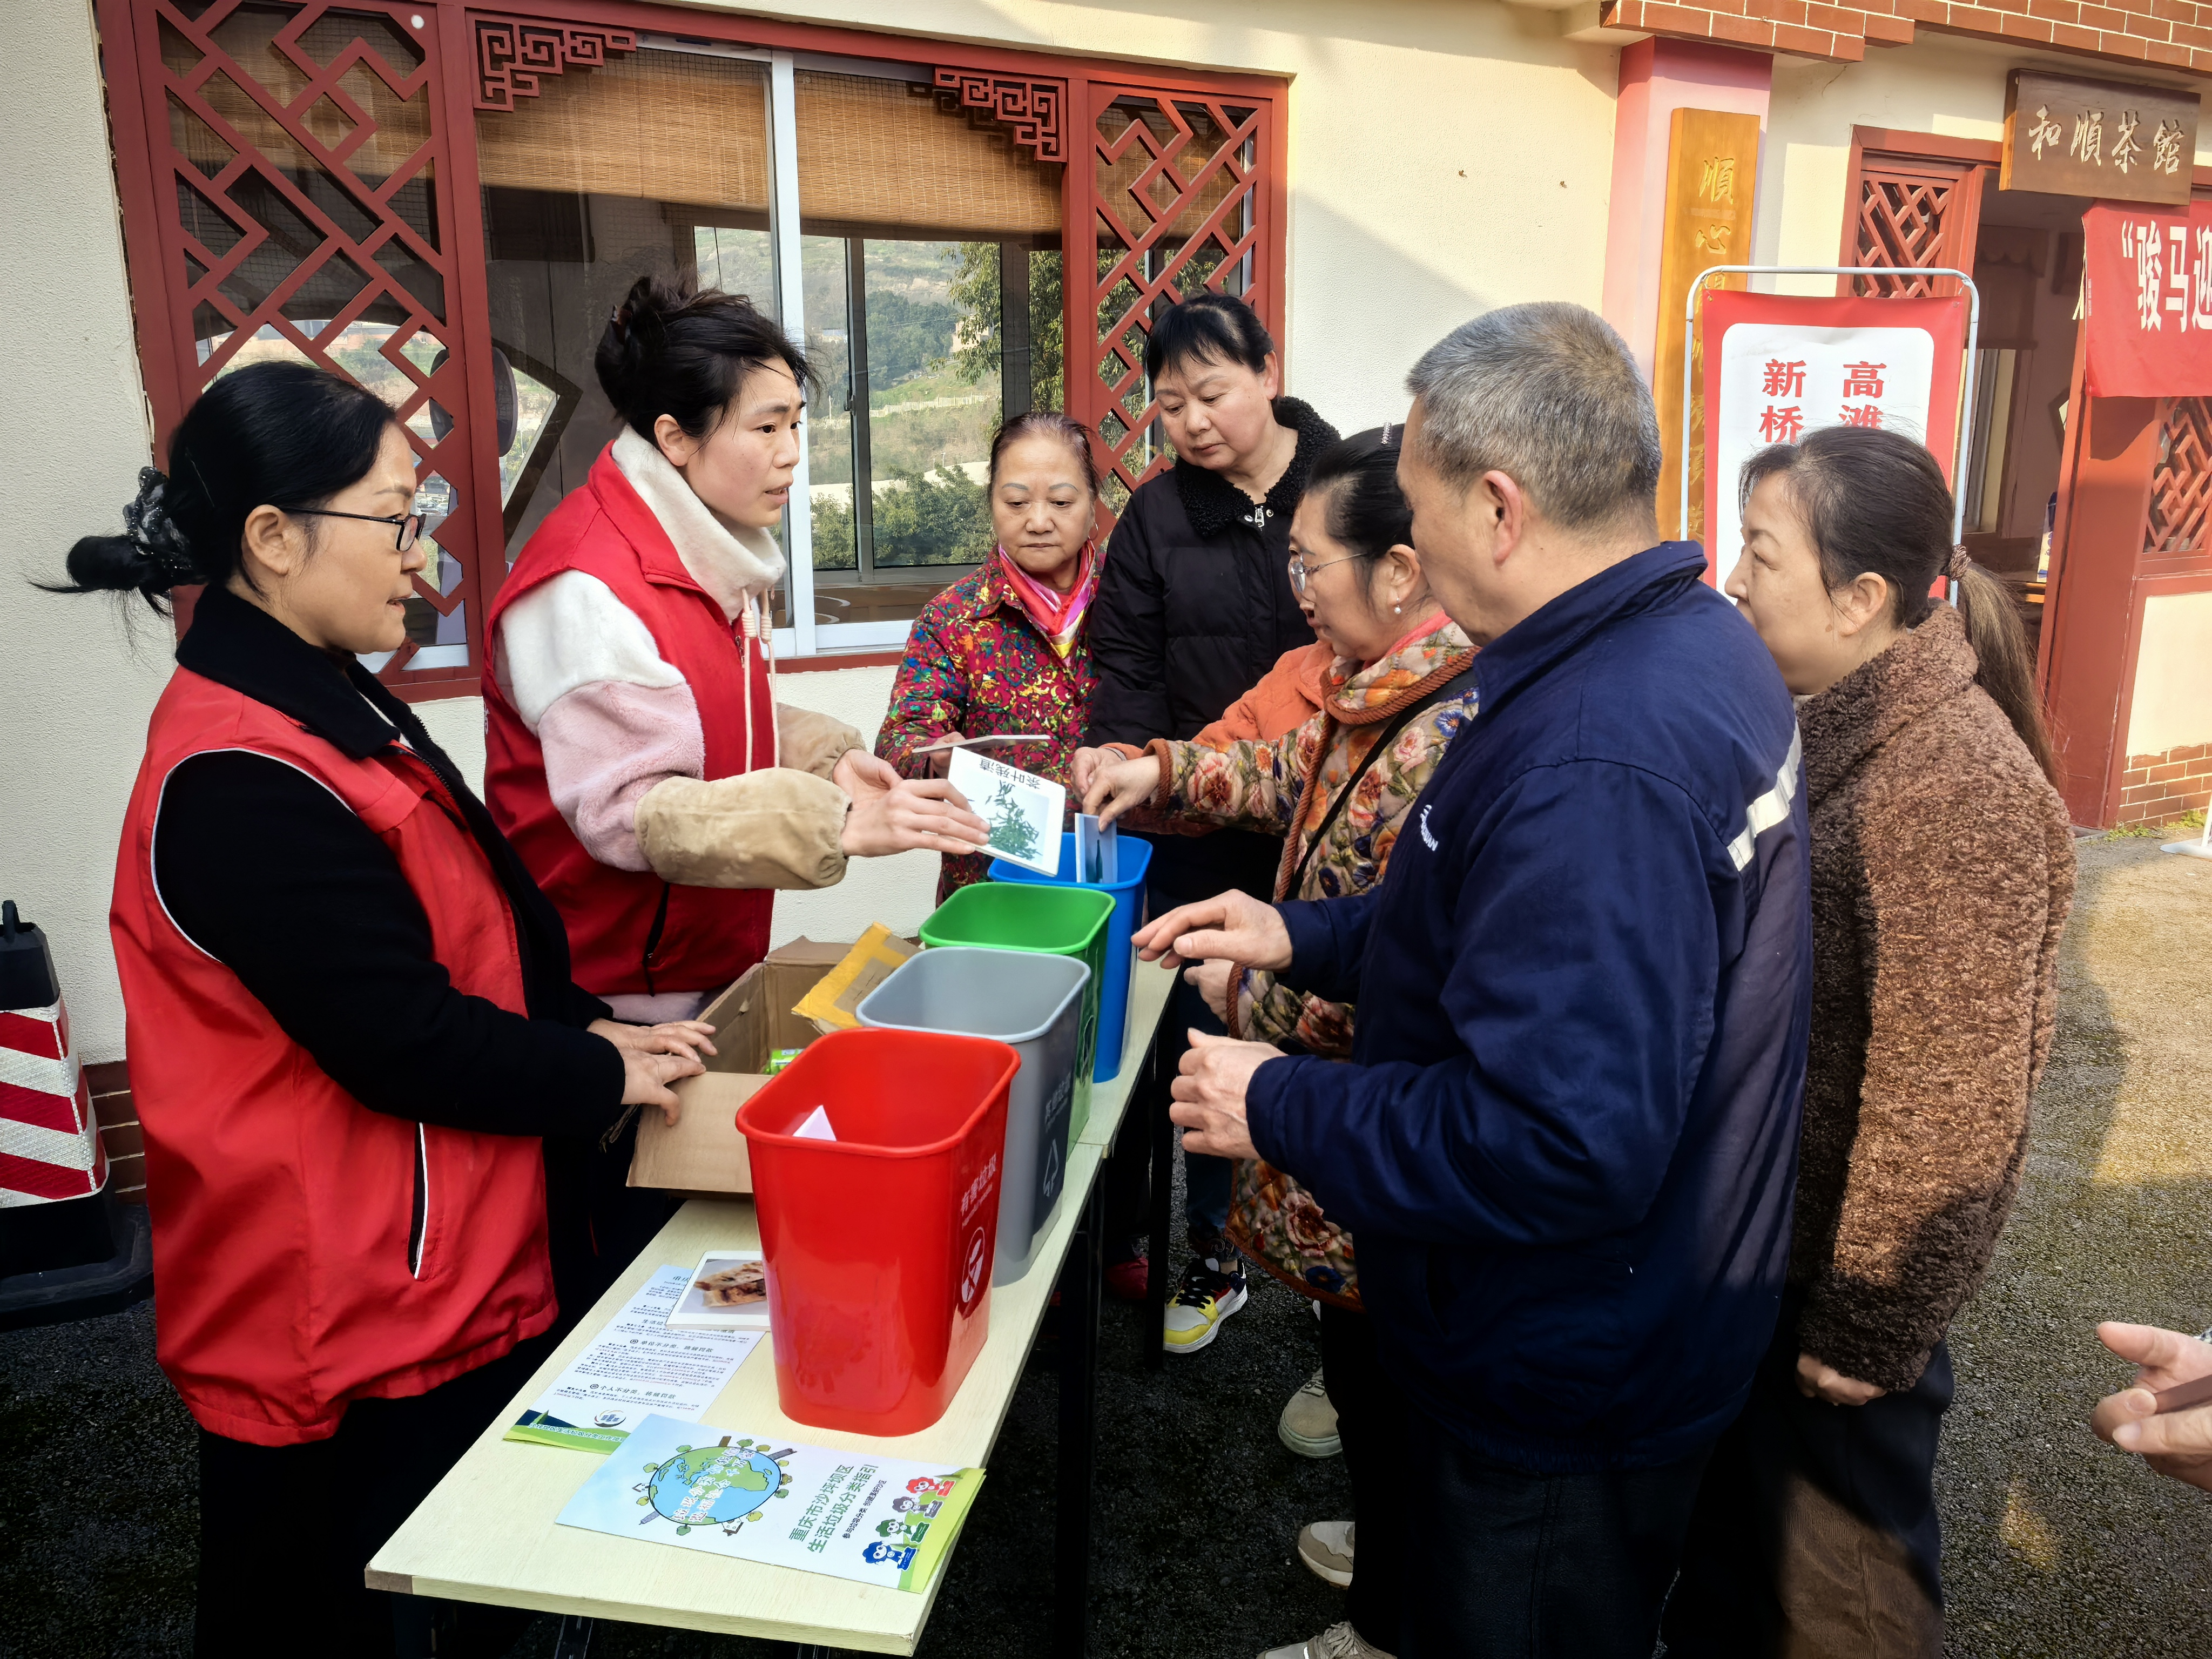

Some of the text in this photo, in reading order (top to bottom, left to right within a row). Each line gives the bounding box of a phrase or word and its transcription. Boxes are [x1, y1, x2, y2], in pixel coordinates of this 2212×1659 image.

[2029, 104, 2184, 174] 和順茶館
[1759, 359, 1807, 444] 新桥
[979, 758, 1041, 790] 茶叶残渣
[788, 1465, 854, 1542] 重庆市沙坪坝区
[807, 1464, 879, 1553] 生活垃圾分类指引
